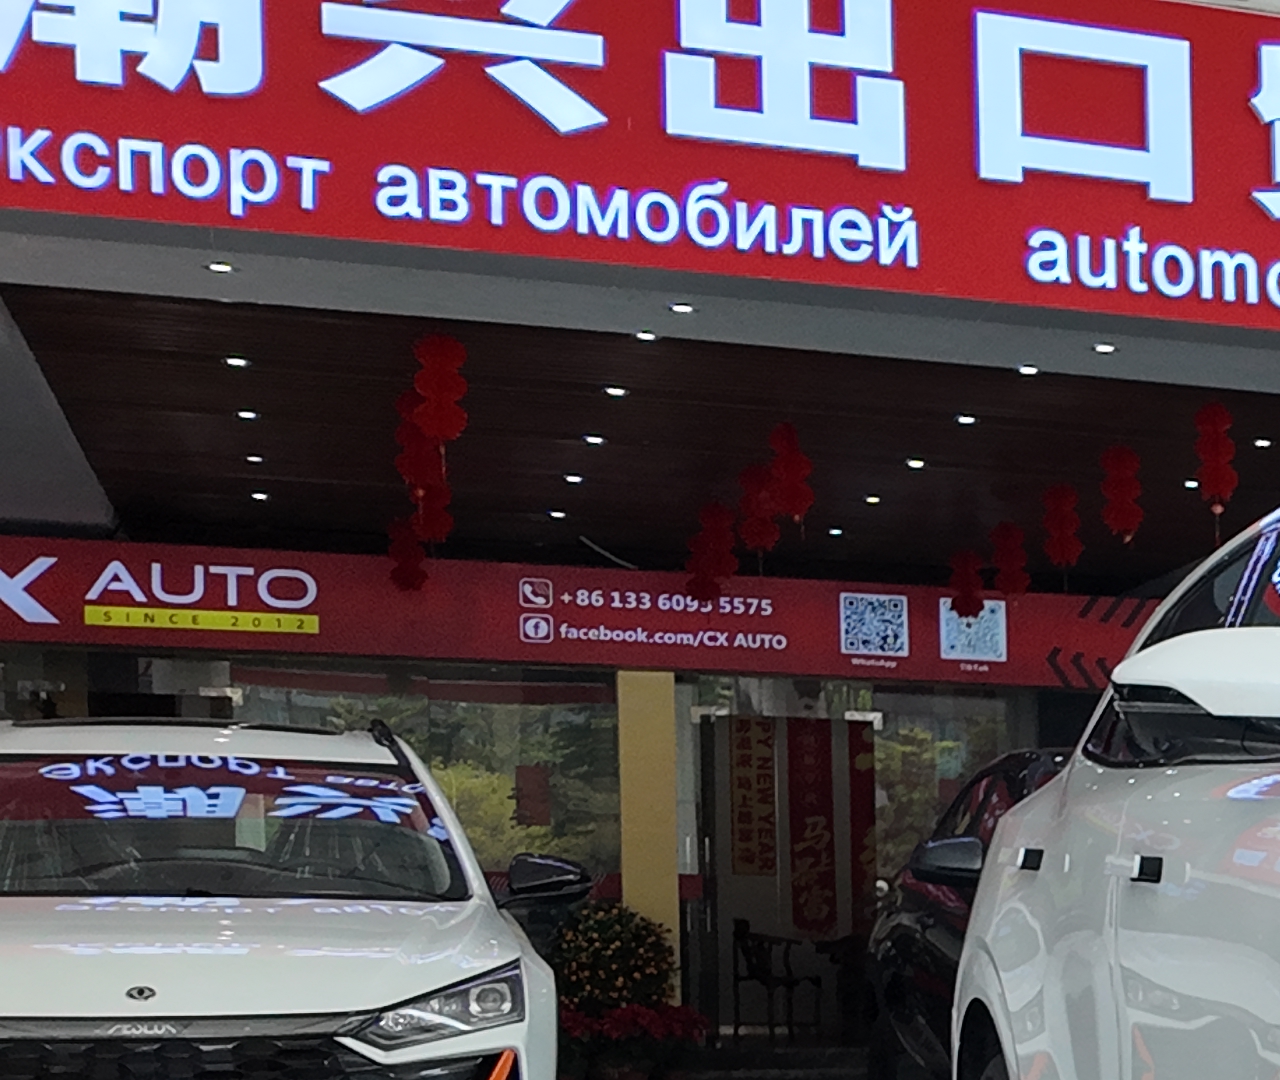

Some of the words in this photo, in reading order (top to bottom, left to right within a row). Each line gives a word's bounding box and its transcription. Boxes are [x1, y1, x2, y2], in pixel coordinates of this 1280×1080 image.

[0, 125, 330, 216] кспорт
[374, 162, 920, 269] автомобилей
[0, 556, 60, 625] X
[83, 559, 319, 609] AUTO
[560, 589, 605, 607] +86
[610, 591, 652, 610] 133
[719, 596, 773, 616] 5575
[102, 611, 201, 627] SINCE
[230, 616, 307, 631] 2012
[559, 622, 729, 648] facebook.com/CX
[733, 632, 787, 650] AUTO
